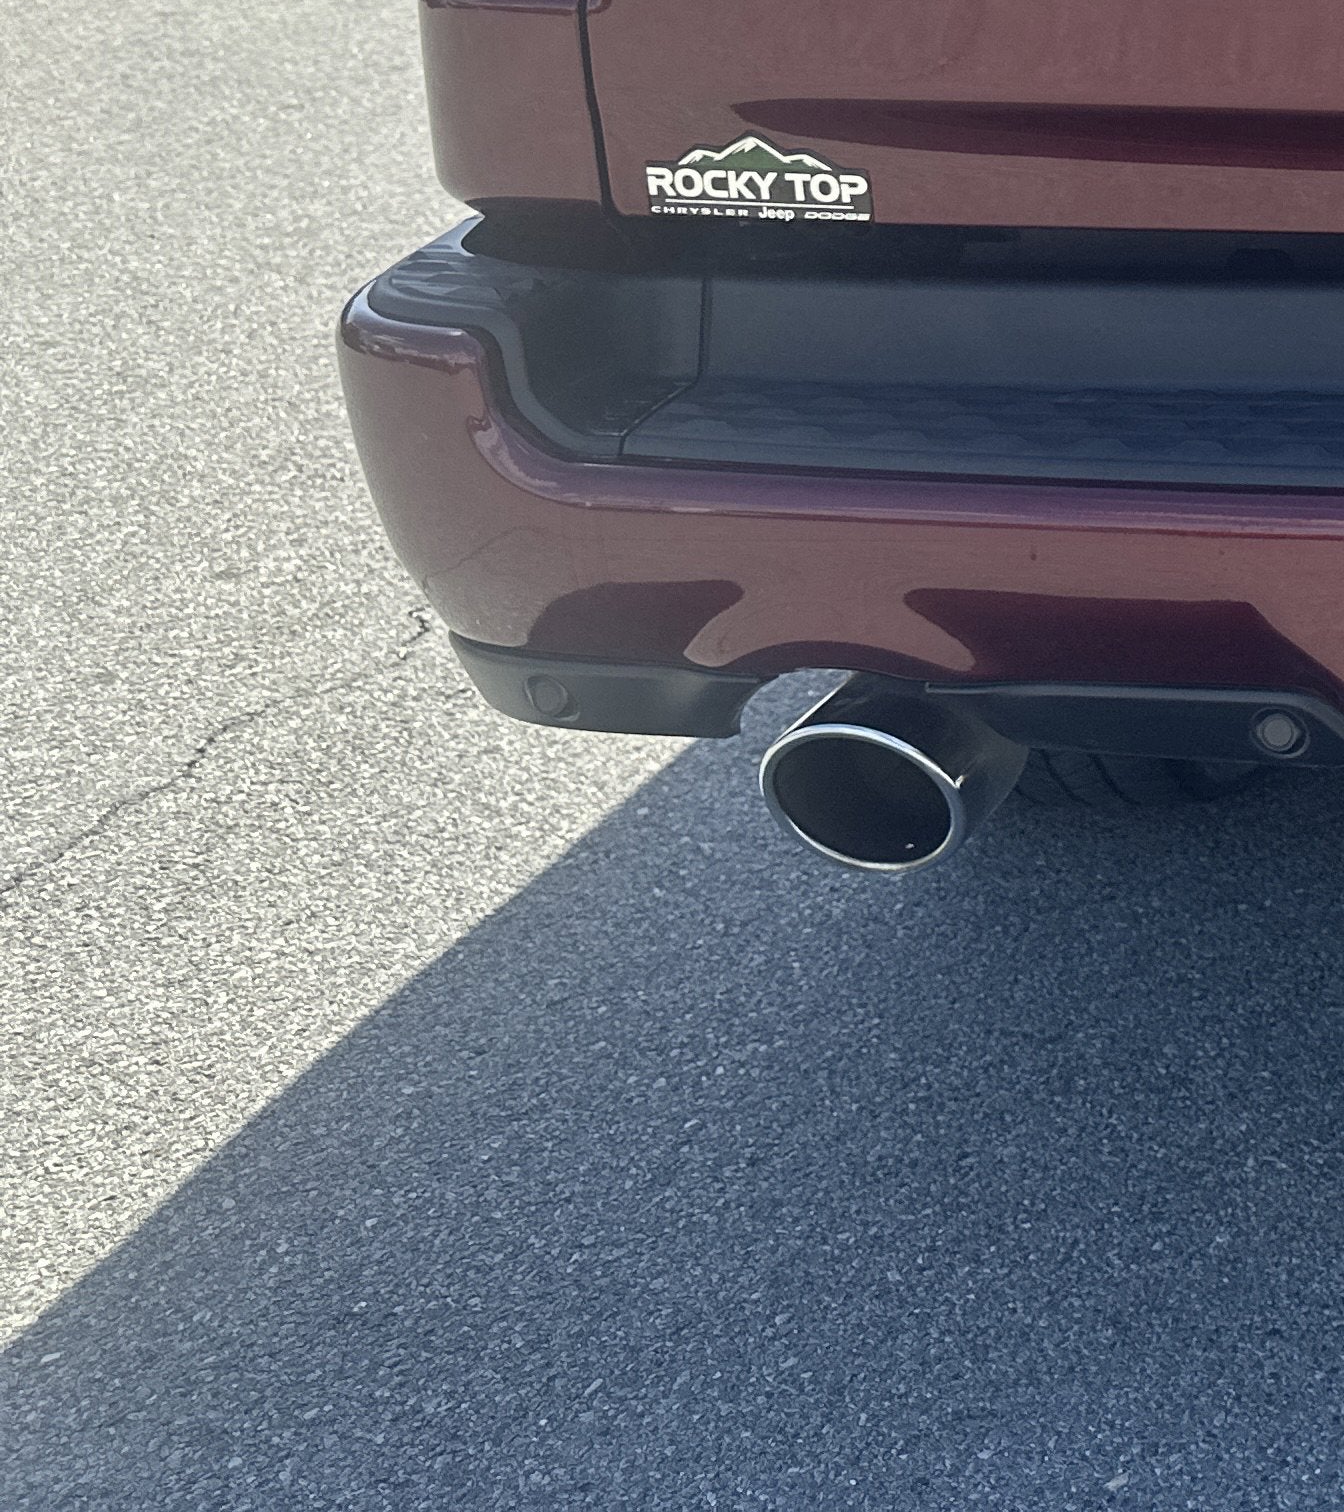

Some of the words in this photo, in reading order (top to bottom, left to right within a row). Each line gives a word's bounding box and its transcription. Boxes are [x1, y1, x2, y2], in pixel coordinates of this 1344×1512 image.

[646, 167, 777, 200] ROCKY
[784, 173, 868, 203] TOP
[650, 205, 749, 217] CHRYSLER
[758, 207, 795, 222] Jeep
[804, 211, 871, 221] DODGE
